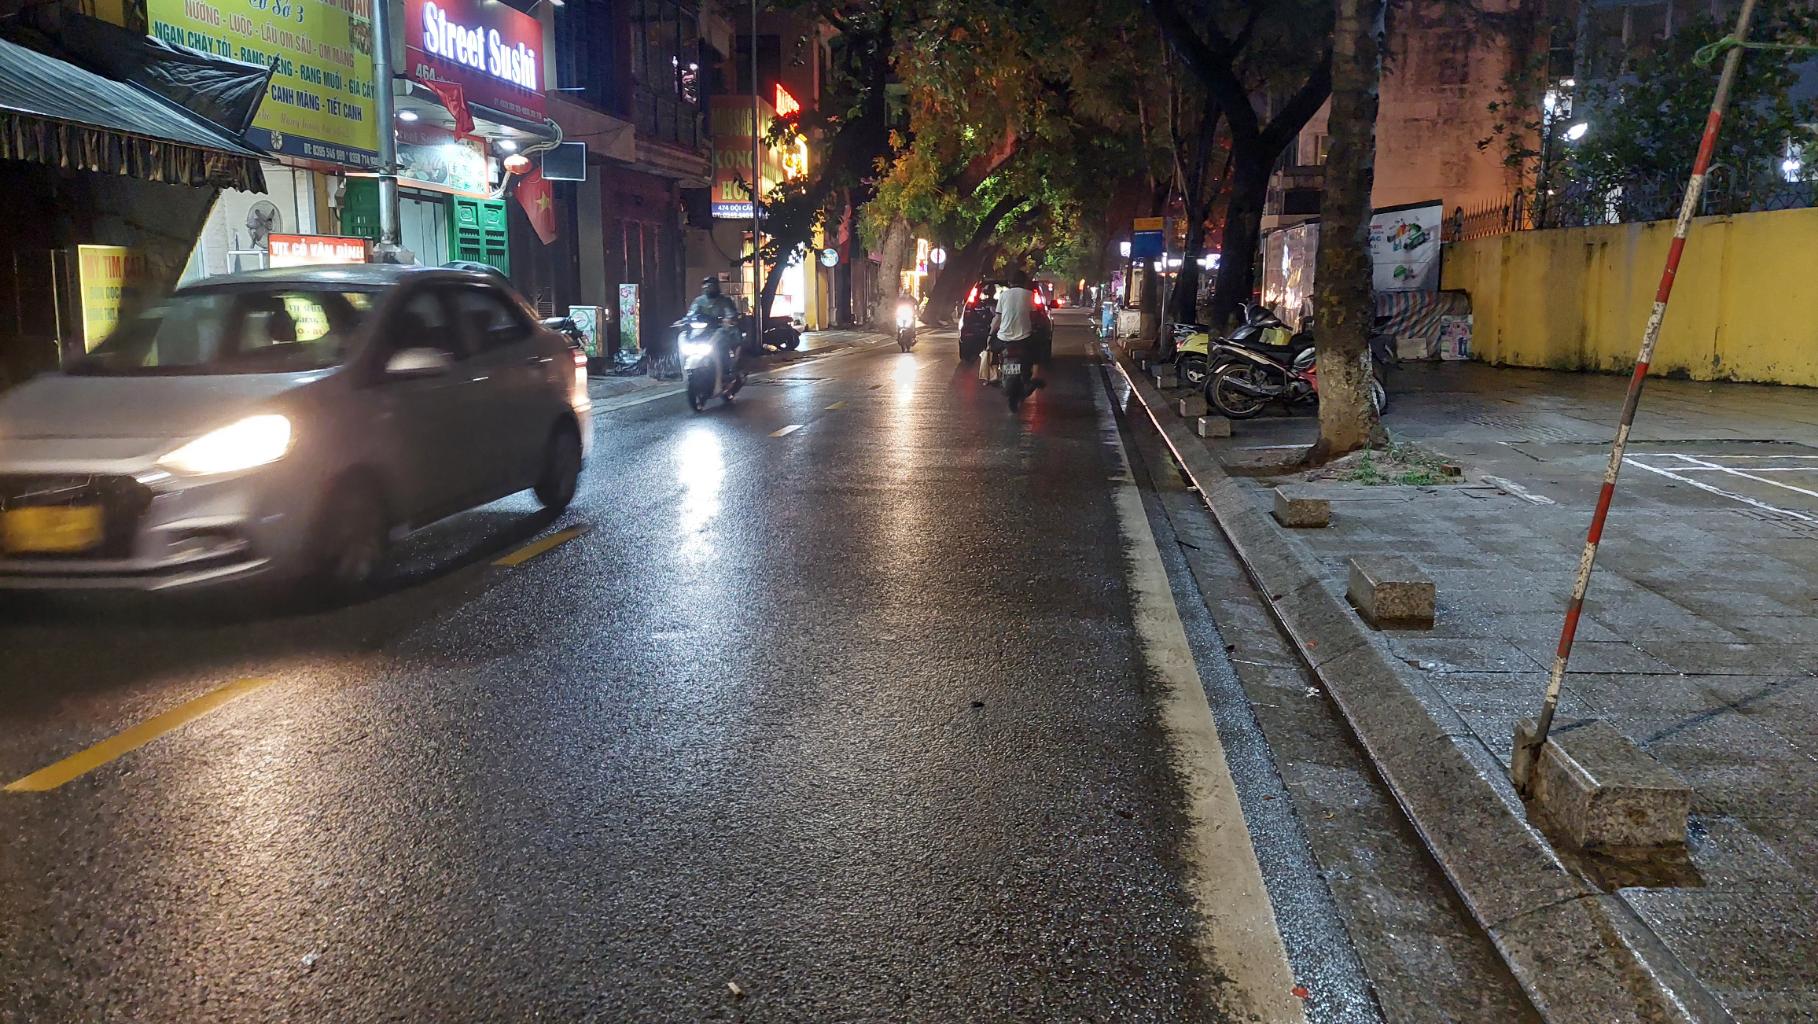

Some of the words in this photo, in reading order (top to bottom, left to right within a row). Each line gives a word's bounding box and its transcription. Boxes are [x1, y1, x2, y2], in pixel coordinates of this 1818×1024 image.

[295, 5, 304, 23] 3
[154, 21, 185, 46] NGAN
[240, 46, 265, 65] RANG
[300, 64, 321, 84] RANG
[423, 1, 486, 71] Street
[488, 28, 537, 91] Sushi
[271, 84, 294, 106] CANH
[343, 103, 363, 122] CANH
